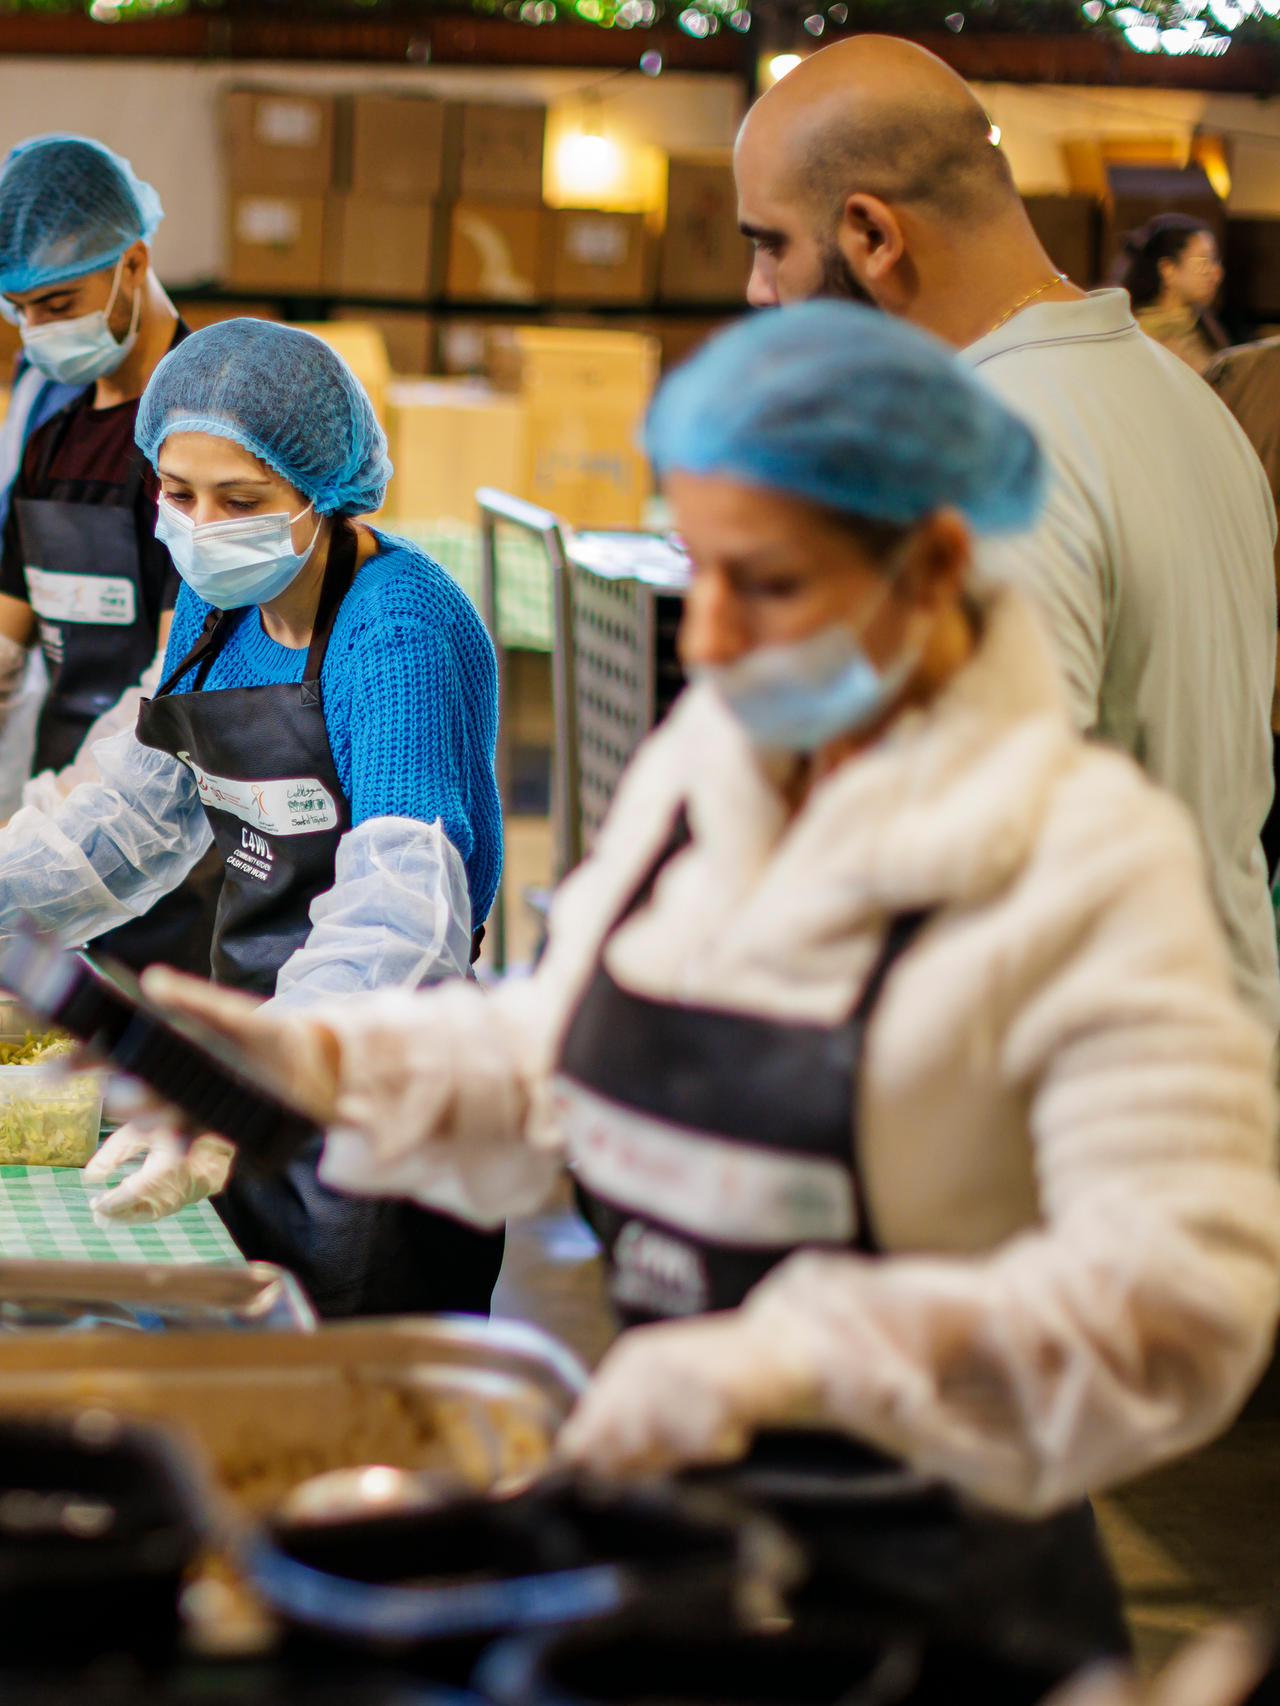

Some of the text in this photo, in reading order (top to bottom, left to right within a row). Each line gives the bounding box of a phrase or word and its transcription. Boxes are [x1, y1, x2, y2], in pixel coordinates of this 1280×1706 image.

[241, 827, 273, 861] C4WL
[226, 856, 268, 881] CASH FOR WORK
